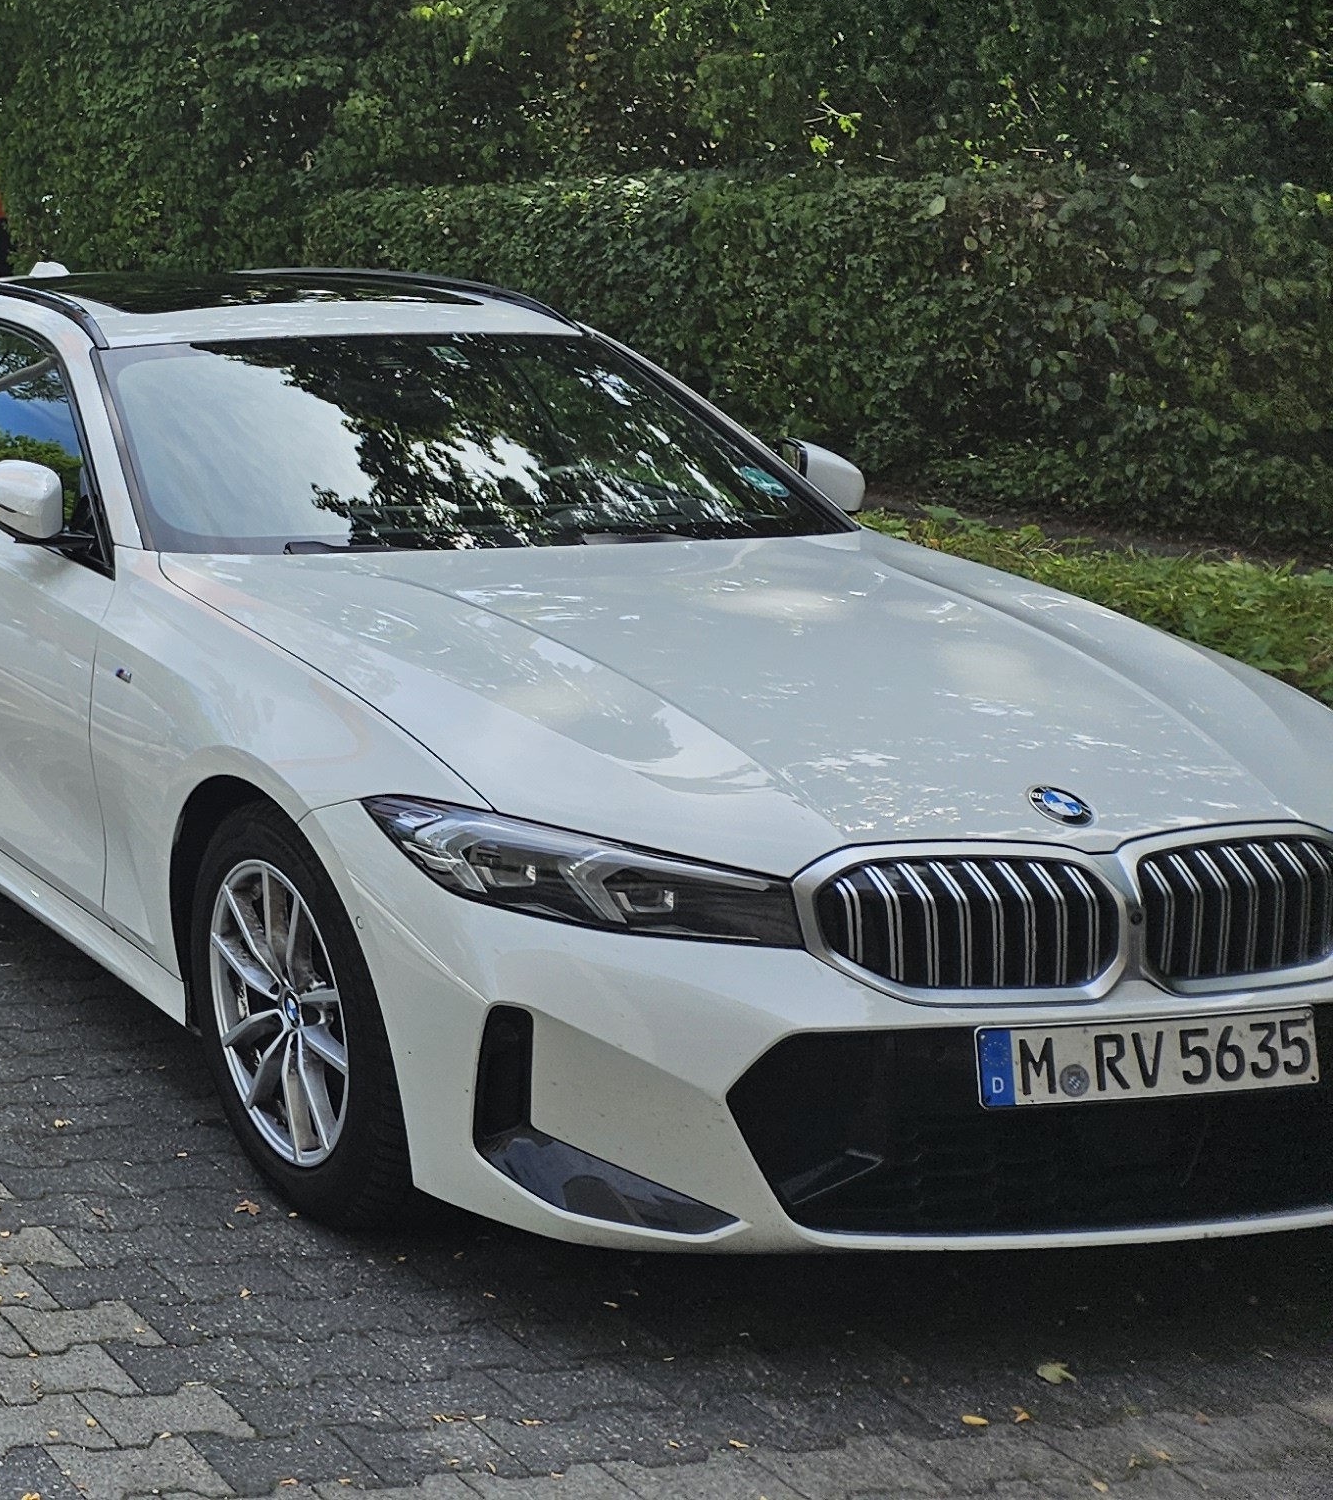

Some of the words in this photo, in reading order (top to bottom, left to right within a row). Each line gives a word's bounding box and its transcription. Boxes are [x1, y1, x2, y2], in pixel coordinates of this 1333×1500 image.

[1019, 1037, 1057, 1095] M
[1094, 1031, 1164, 1091] RV
[1179, 1018, 1311, 1085] 5635
[992, 1077, 1004, 1094] D
